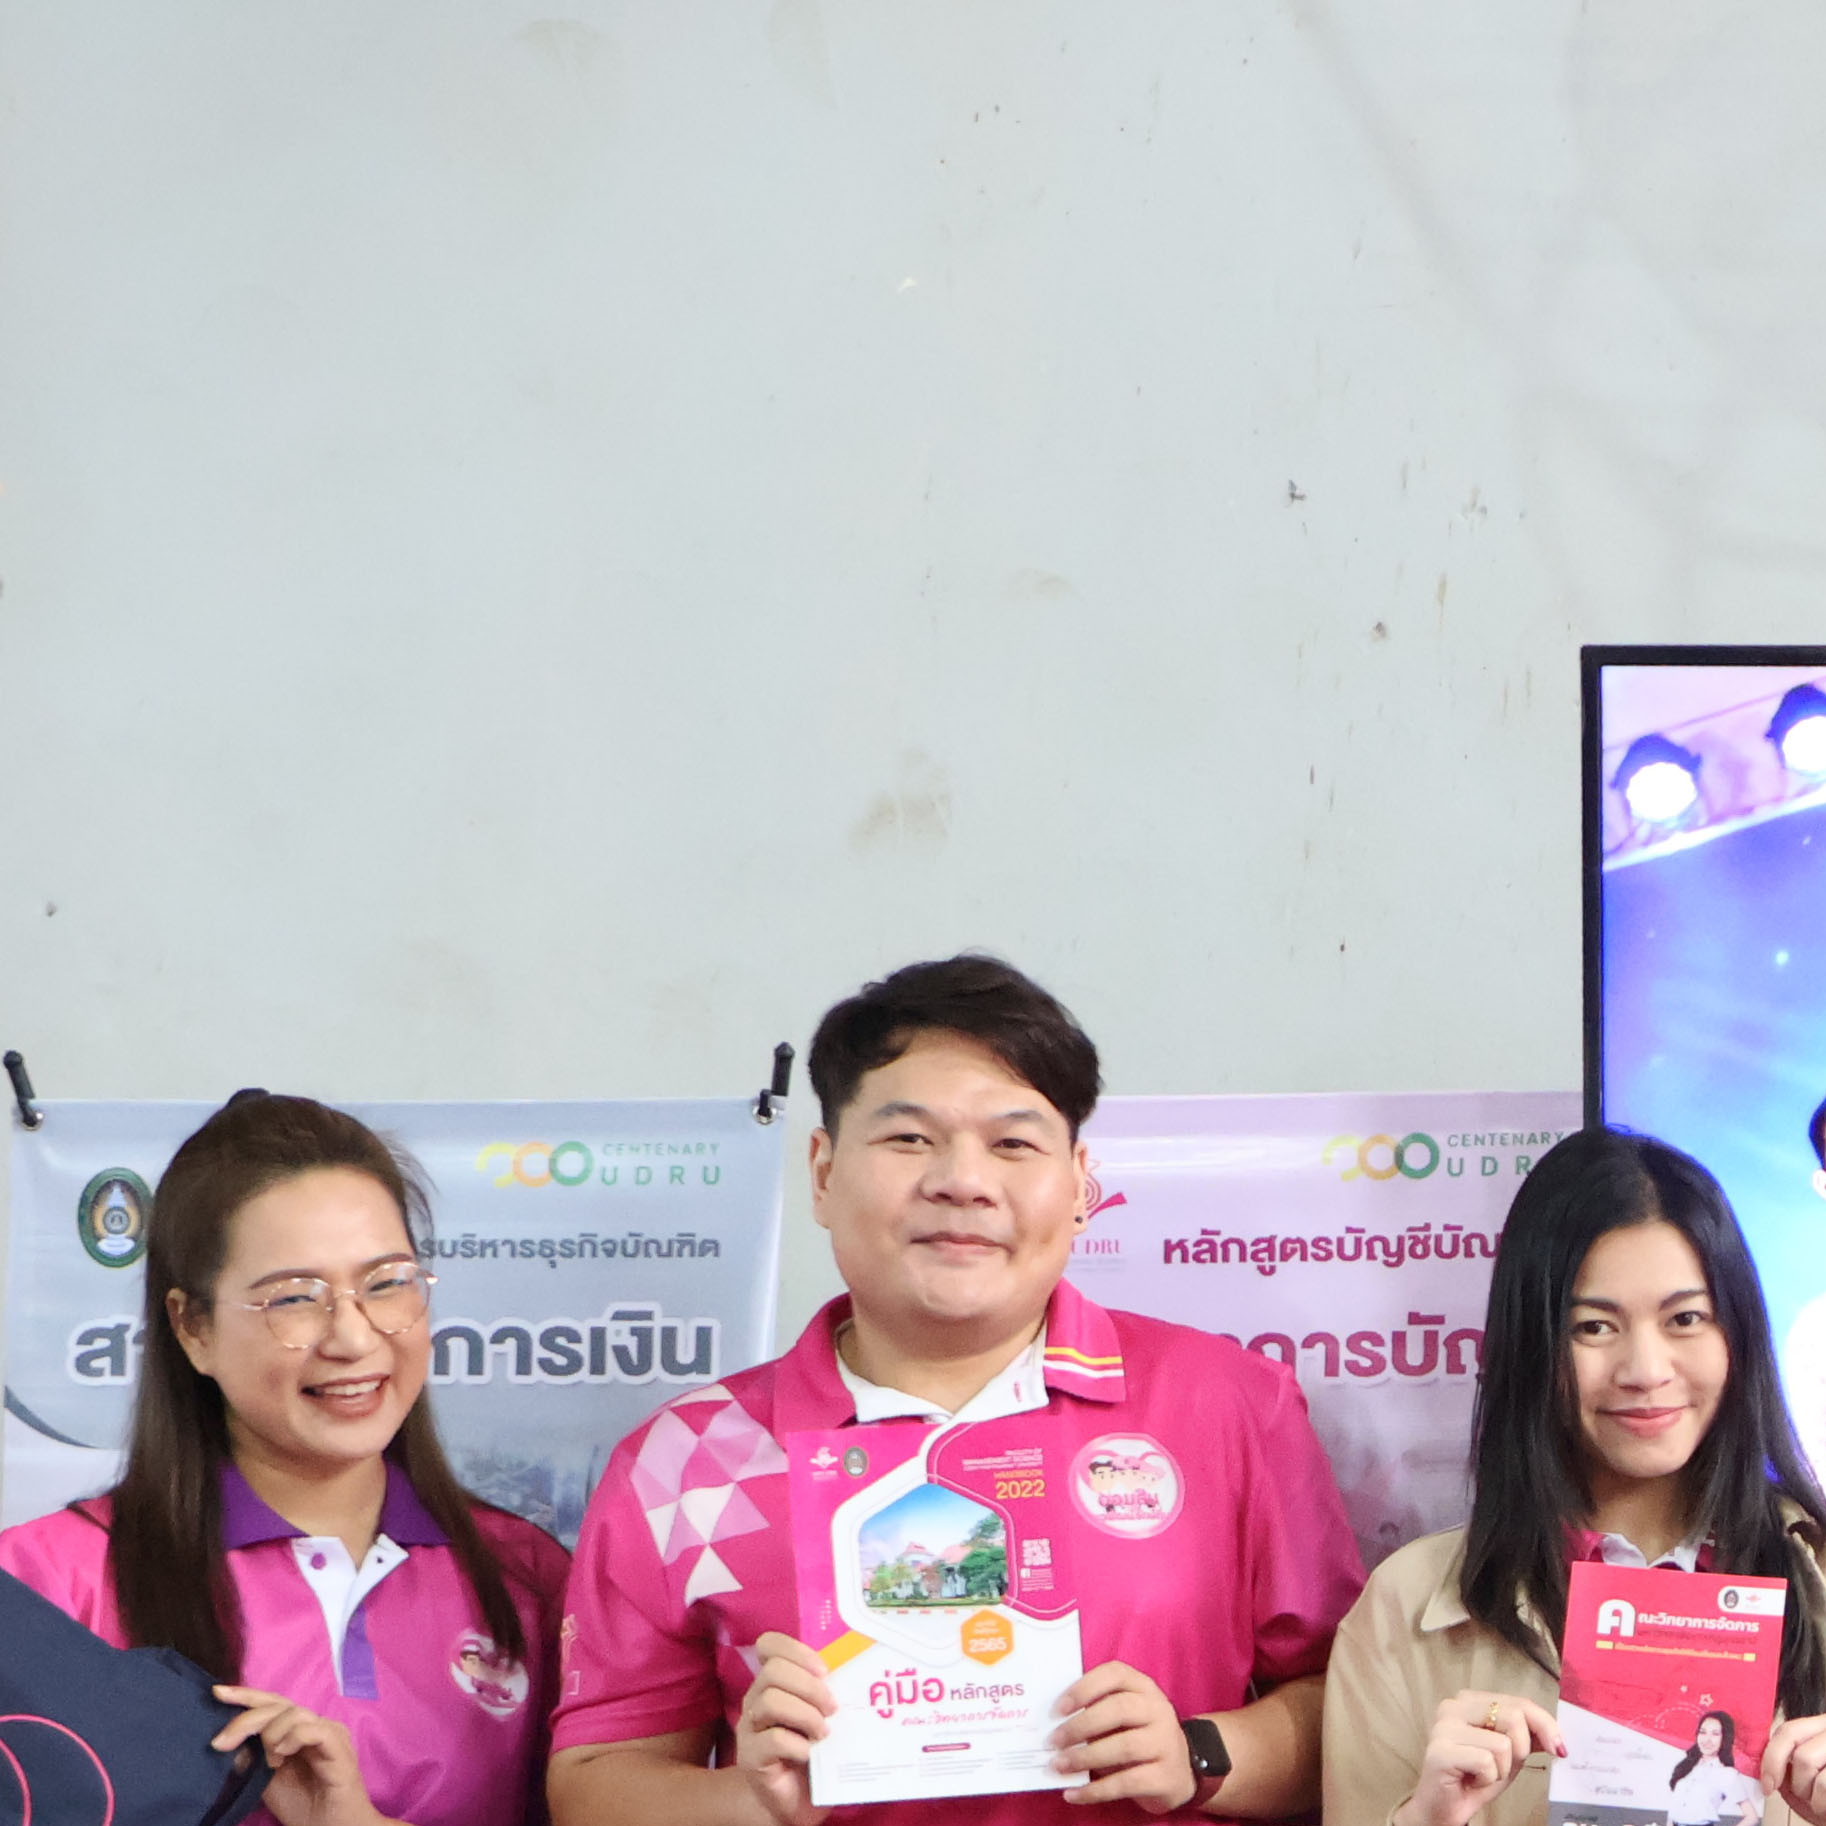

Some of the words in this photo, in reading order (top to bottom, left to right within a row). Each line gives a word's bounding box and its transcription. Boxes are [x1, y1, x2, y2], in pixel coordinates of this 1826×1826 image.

[1446, 1130, 1564, 1148] CENTENARY
[602, 1142, 721, 1156] CENTENARY
[995, 1478, 1046, 1499] 2022
[968, 1637, 1007, 1653] 2565
[868, 1668, 946, 1720] คู่มือ
[949, 1677, 1025, 1704] หลักสูตร
